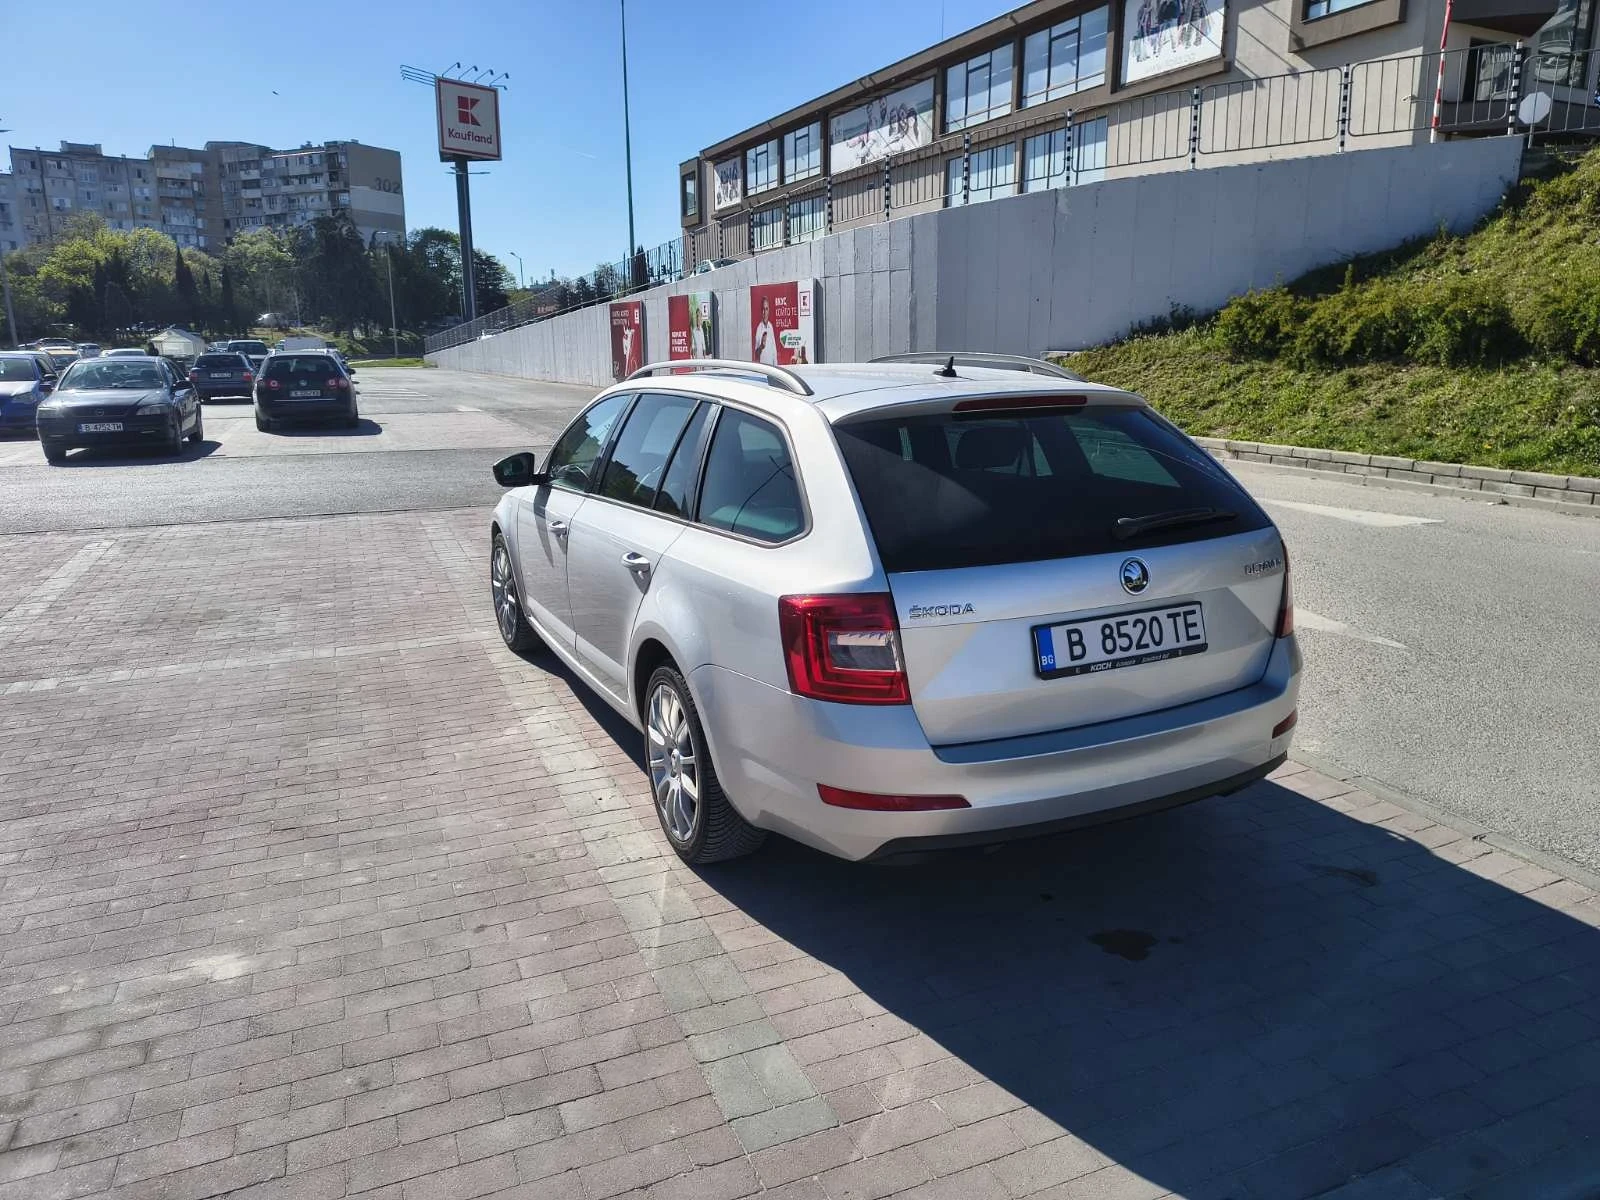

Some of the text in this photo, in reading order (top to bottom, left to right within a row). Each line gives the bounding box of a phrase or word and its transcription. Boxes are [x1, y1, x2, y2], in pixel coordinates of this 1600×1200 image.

[447, 127, 493, 144] Kaufland
[374, 176, 401, 194] 302
[909, 602, 977, 619] ŠKODA
[1066, 609, 1201, 661] B 8520 TE
[1041, 655, 1055, 666] BG
[1090, 661, 1112, 672] KOCH
